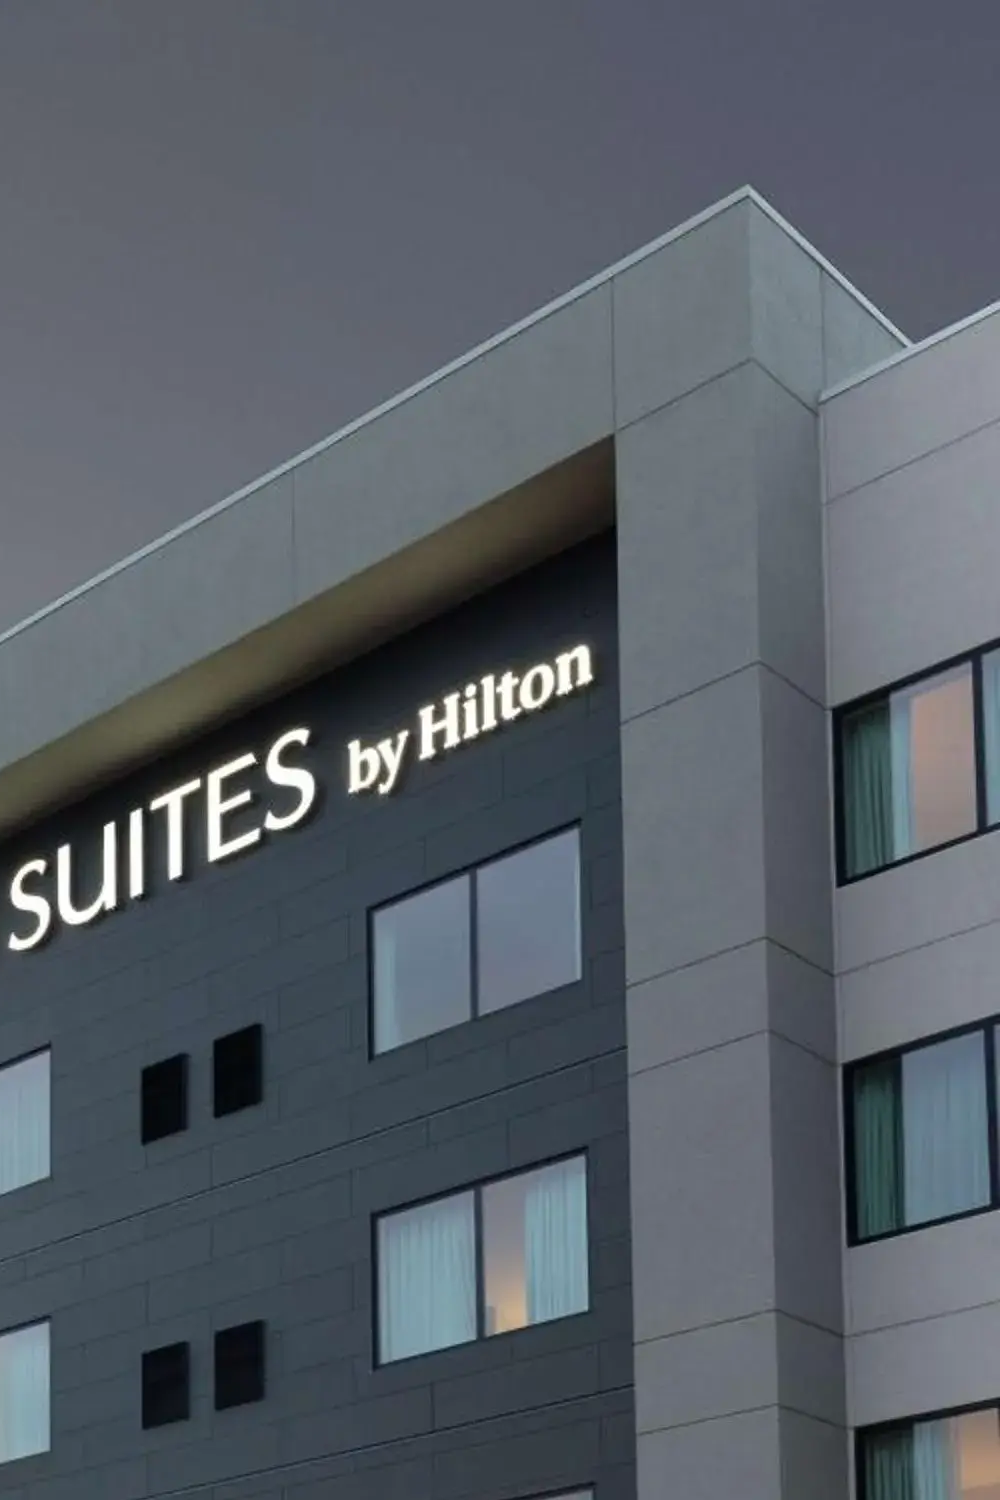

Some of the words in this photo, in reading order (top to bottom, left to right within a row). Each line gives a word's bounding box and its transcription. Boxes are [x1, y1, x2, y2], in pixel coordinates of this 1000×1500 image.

[7, 727, 316, 951] SUITES
[346, 729, 410, 795] by
[418, 644, 594, 761] Hilton
